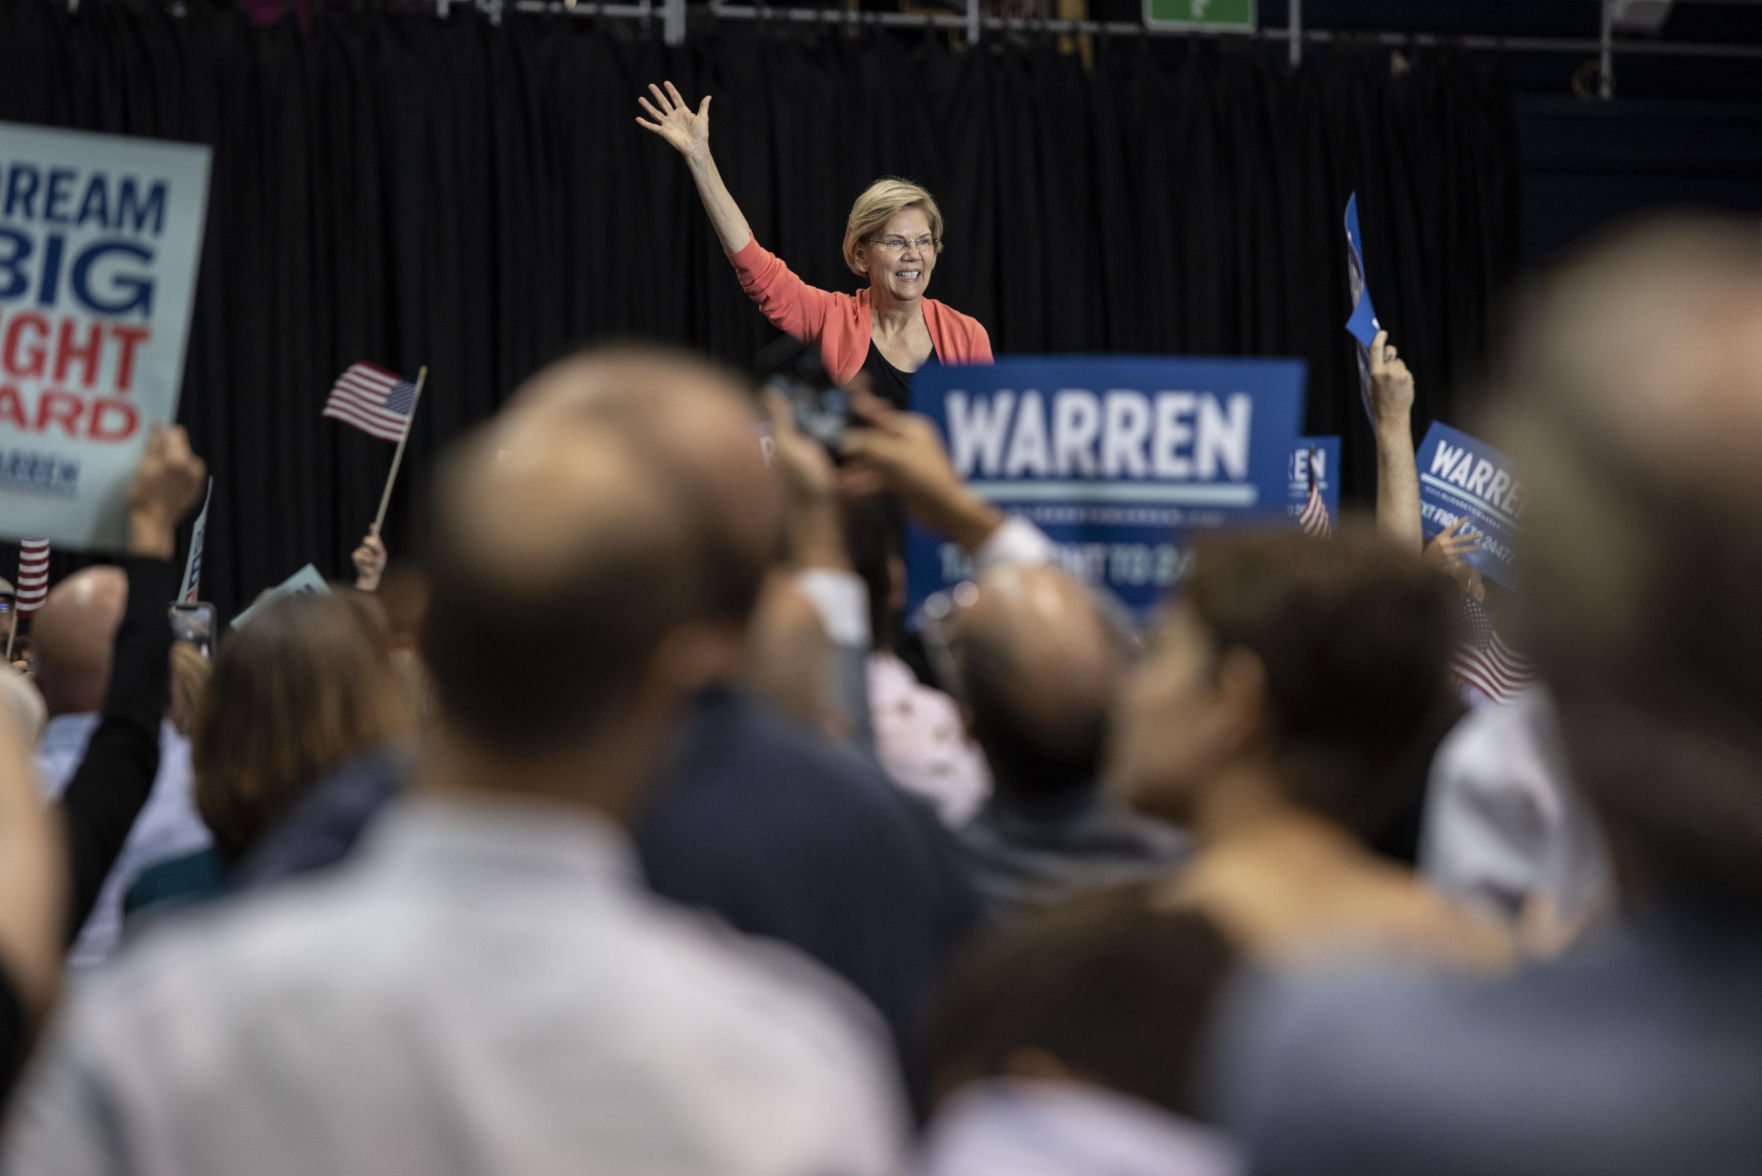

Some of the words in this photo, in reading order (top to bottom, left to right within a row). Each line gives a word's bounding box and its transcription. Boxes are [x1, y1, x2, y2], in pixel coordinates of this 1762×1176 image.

[0, 161, 168, 236] REAM
[0, 226, 155, 318] BIG
[0, 310, 152, 391] GHT
[944, 388, 1254, 480] WARREN
[1287, 447, 1326, 482] EN
[1429, 439, 1525, 519] WARRE
